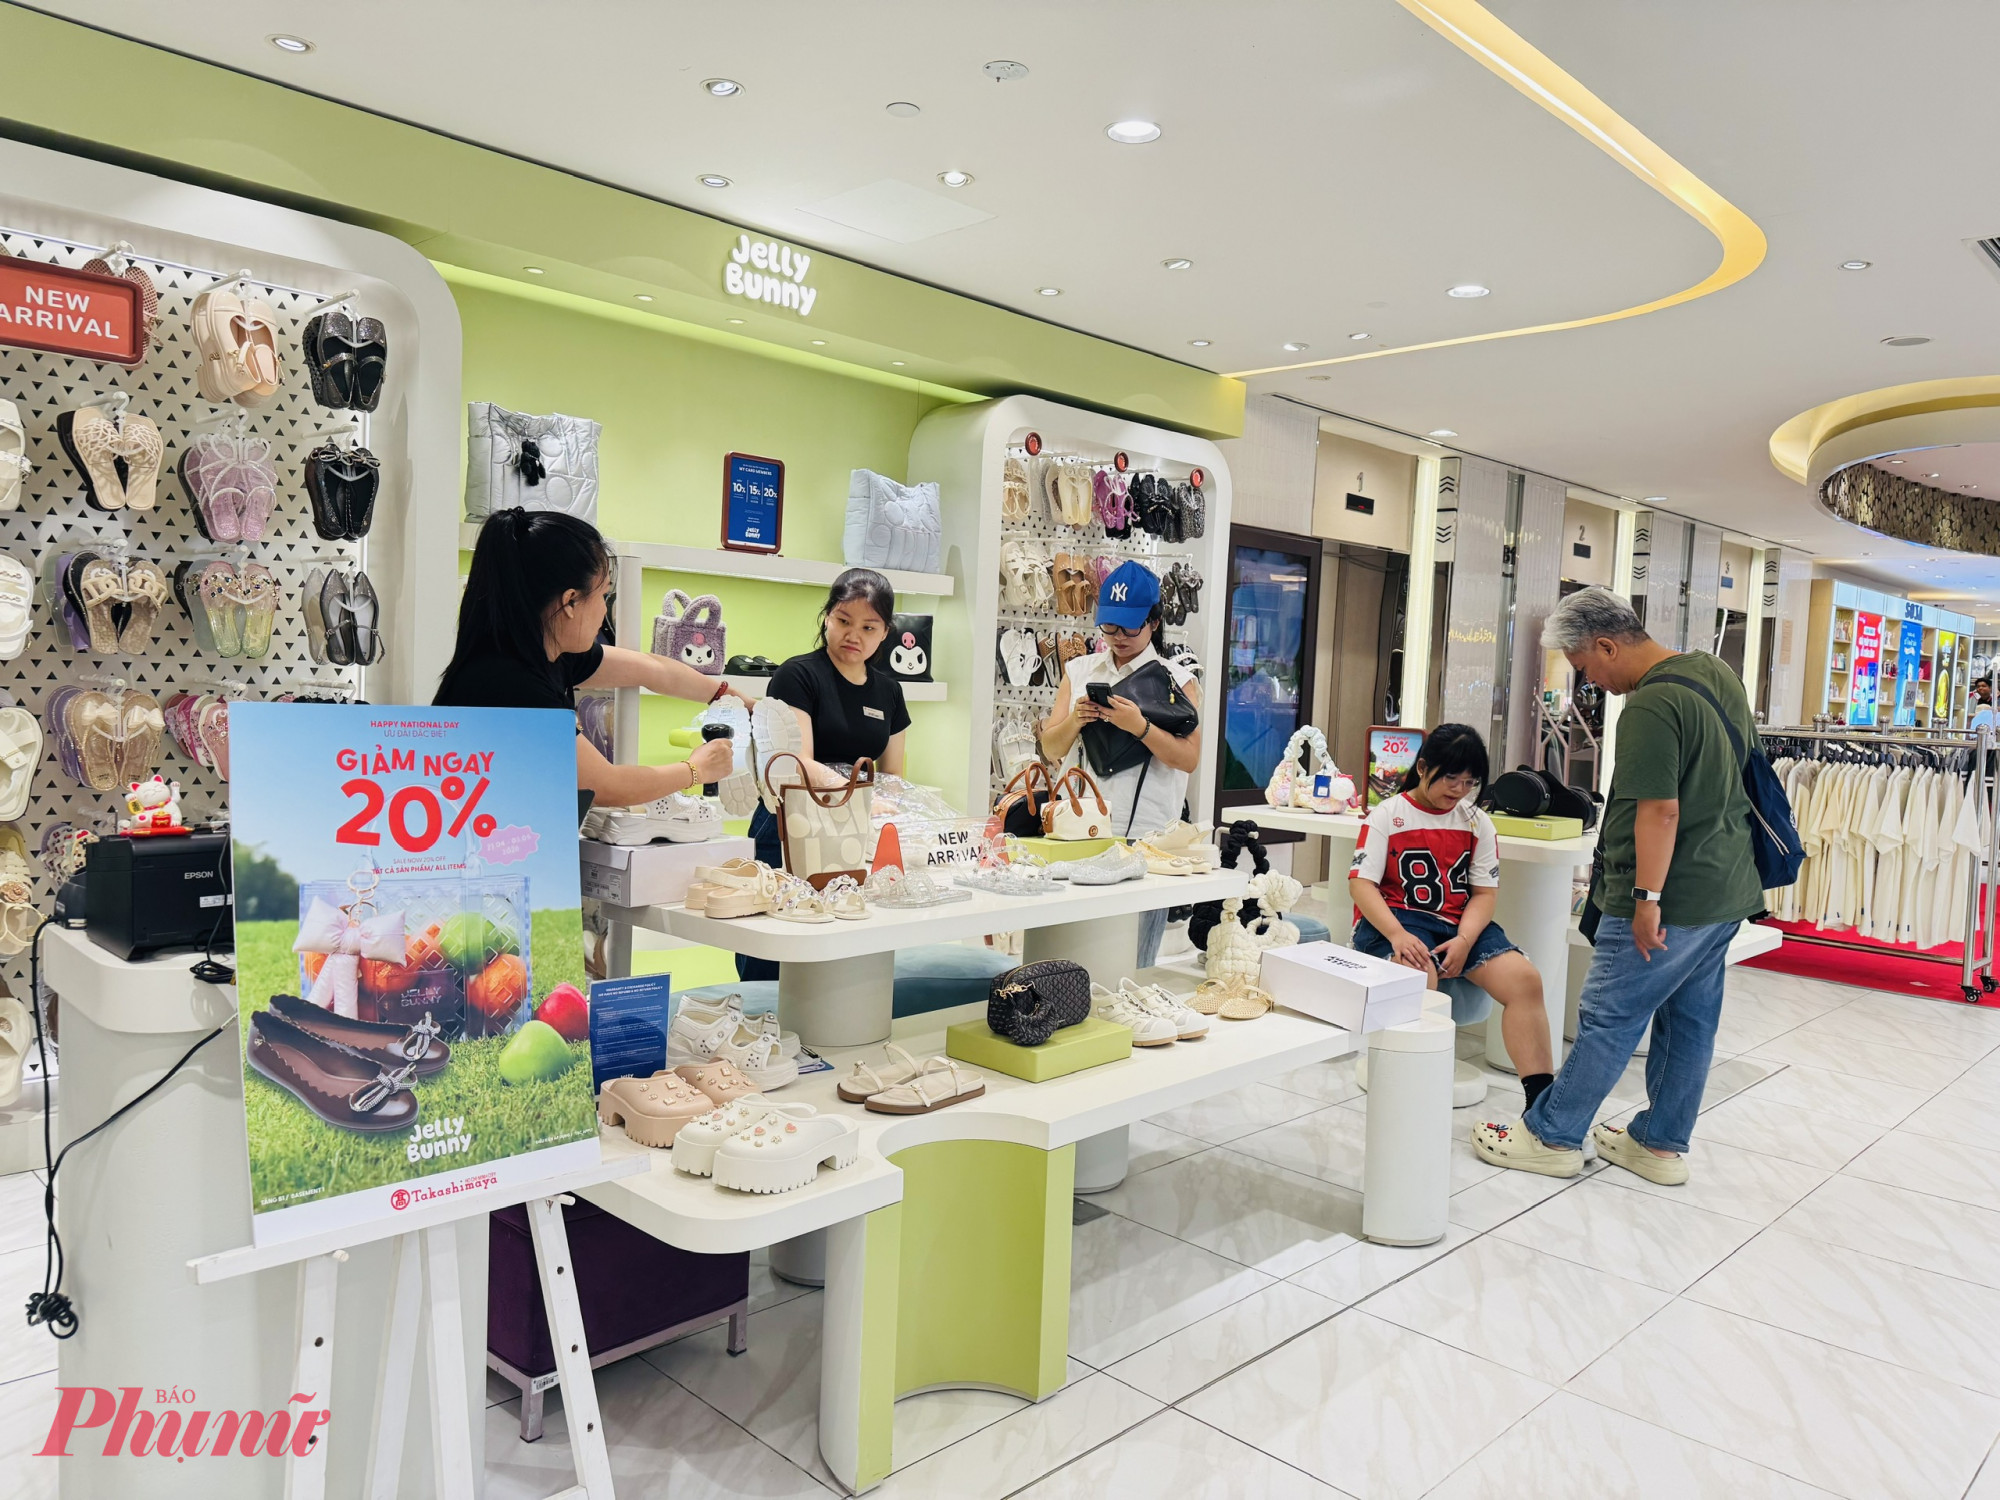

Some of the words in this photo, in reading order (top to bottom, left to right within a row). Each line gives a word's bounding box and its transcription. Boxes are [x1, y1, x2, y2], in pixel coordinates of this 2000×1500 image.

[732, 234, 810, 283] Jelly
[25, 285, 90, 313] NEW
[726, 262, 817, 316] Bunny
[0, 303, 120, 340] ARRIVAL
[732, 482, 746, 494] 10%
[749, 485, 761, 496] 15%
[763, 487, 778, 499] 20%
[1356, 471, 1363, 492] 1
[1579, 525, 1585, 541] 2
[370, 720, 398, 728] HAPPY
[1382, 740, 1409, 754] 20%
[336, 744, 415, 776] GIẢM
[423, 751, 495, 777] NGAY
[336, 776, 497, 853] 20%
[938, 831, 968, 846] NEW
[184, 870, 214, 880] EPSON
[409, 1115, 464, 1142] Jelly
[407, 1133, 472, 1163] Bunny
[411, 1176, 498, 1202] Takashimaya
